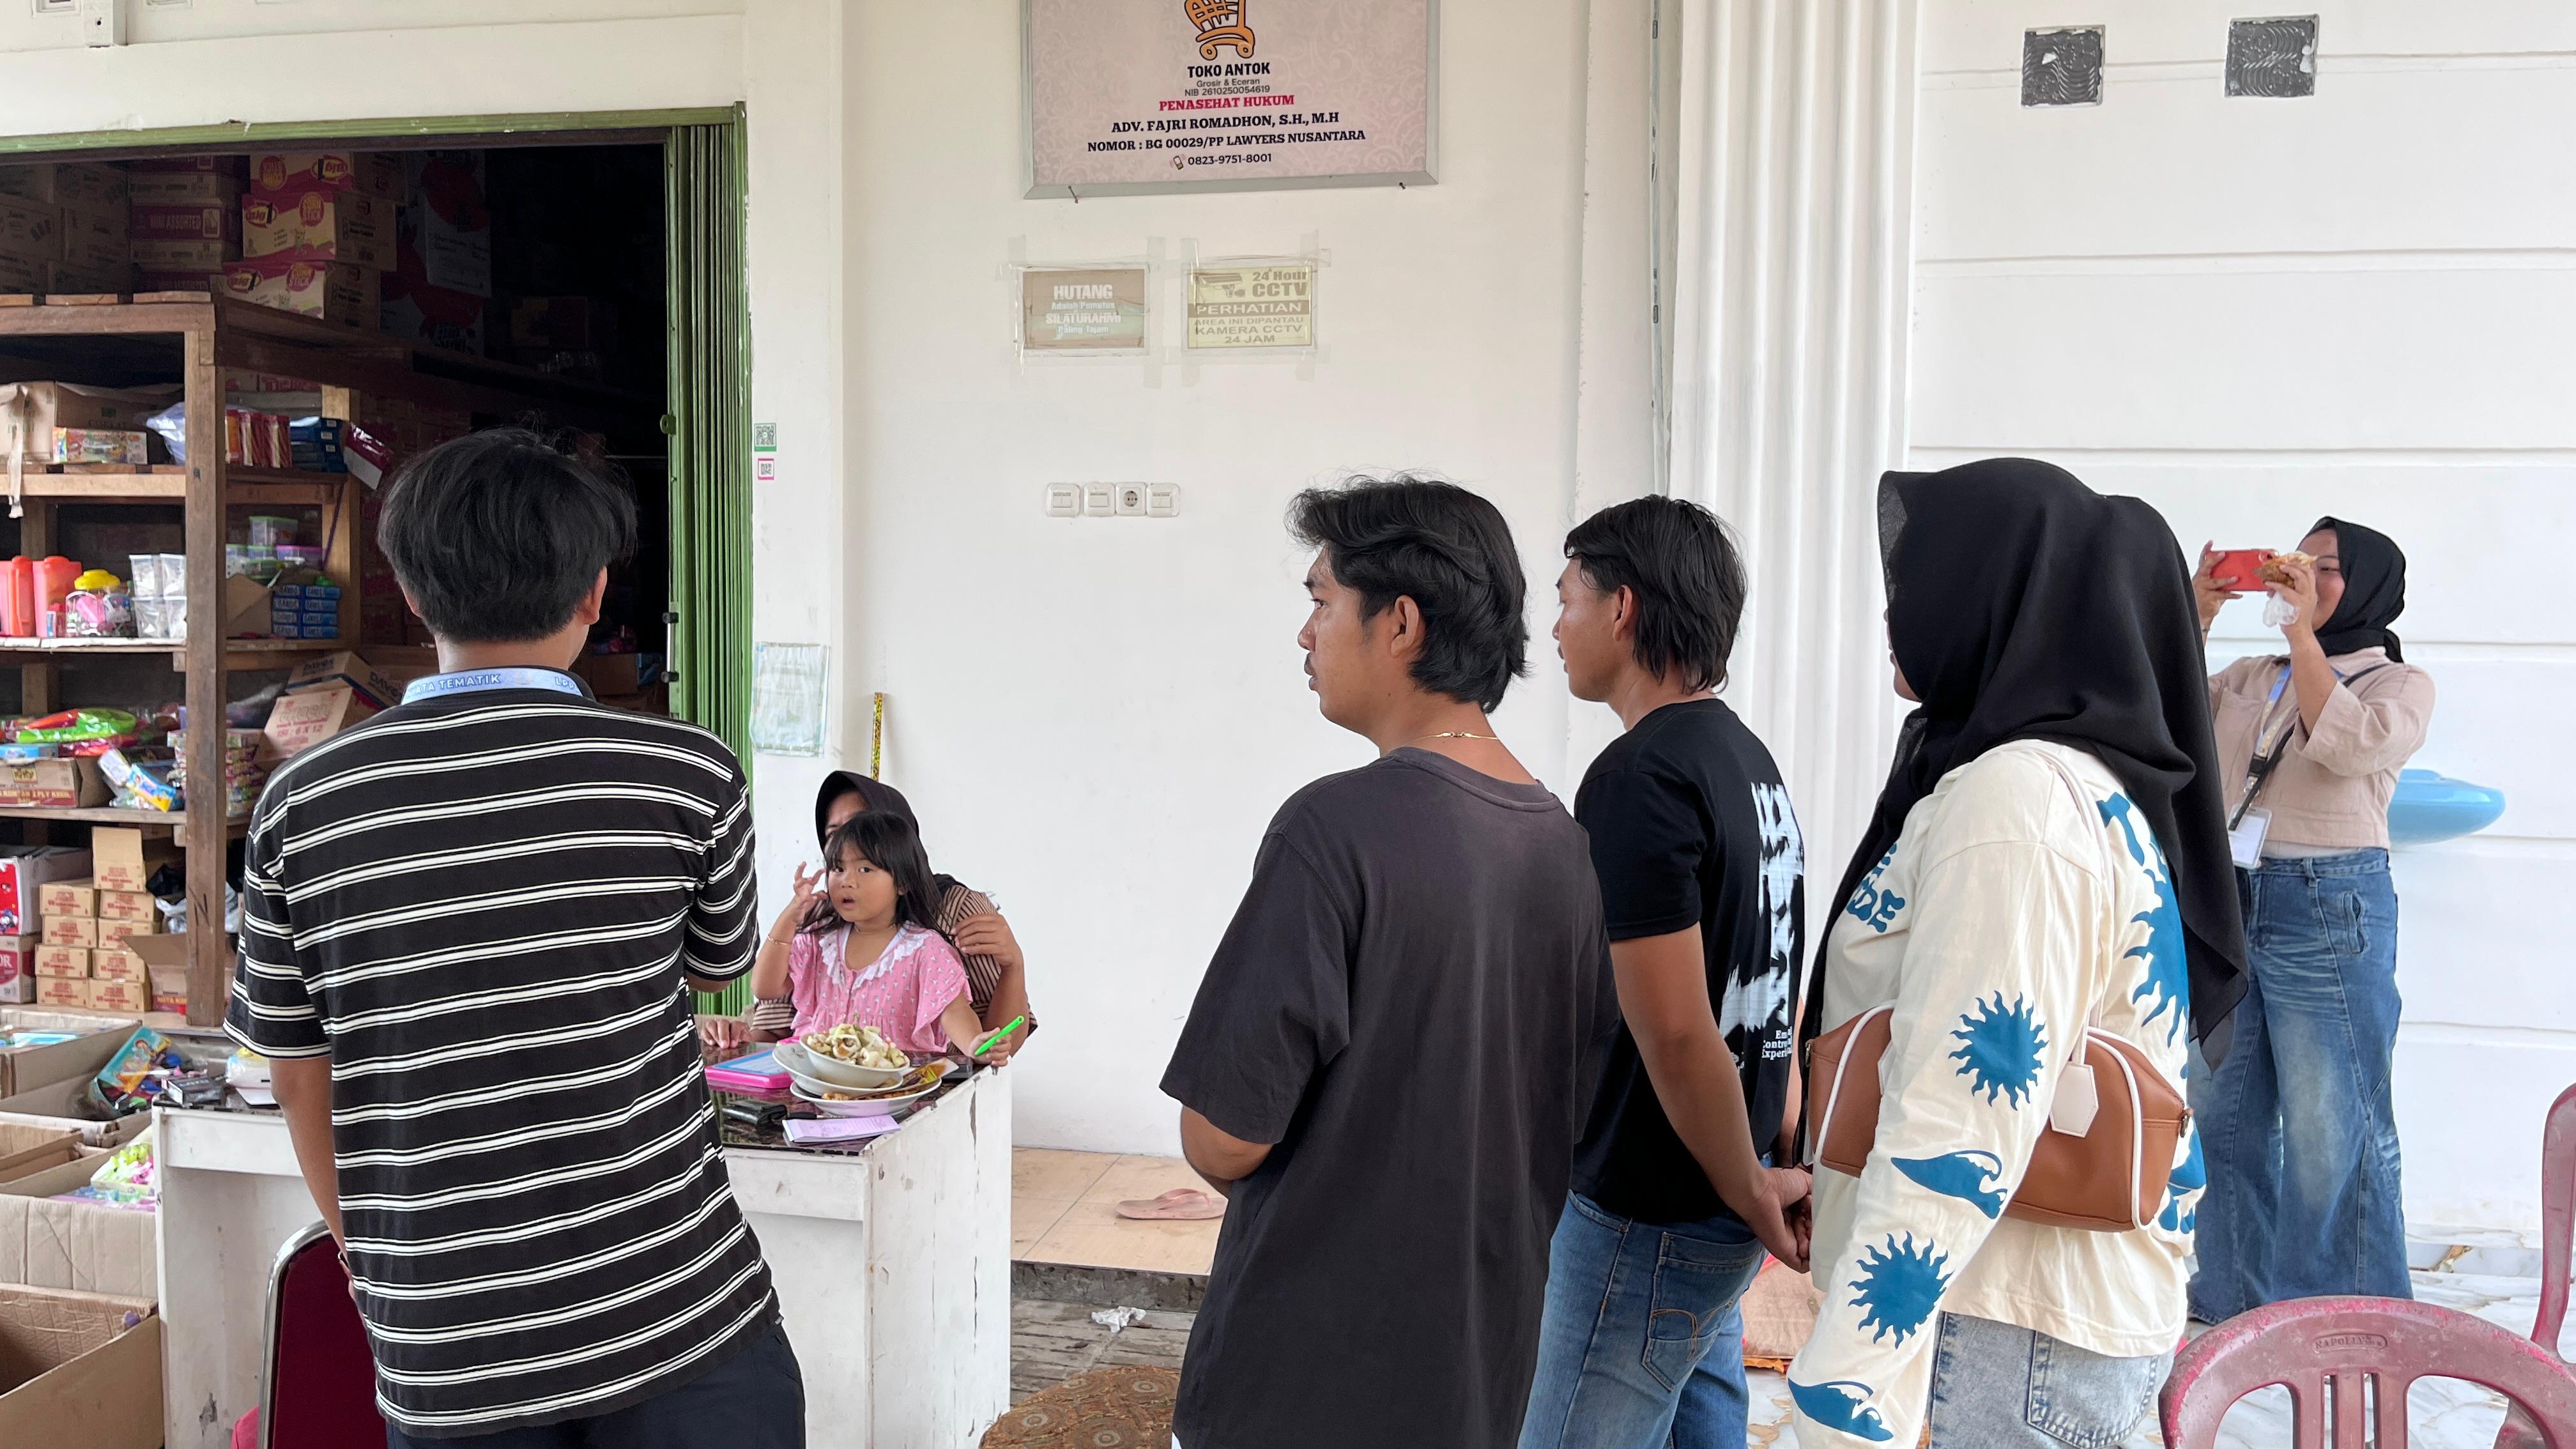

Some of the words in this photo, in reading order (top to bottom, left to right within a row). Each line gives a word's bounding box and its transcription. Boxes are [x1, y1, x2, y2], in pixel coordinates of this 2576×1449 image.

[1187, 65, 1222, 78] TOKO
[1225, 62, 1270, 76] ANTOK
[1197, 79, 1222, 88] Grosir
[1232, 78, 1260, 86] Eceran
[1184, 88, 1199, 96] NIB
[1159, 97, 1240, 111] PENASEHAT
[1243, 95, 1294, 107] HUKUM
[1111, 122, 1144, 133] ADV.
[1147, 119, 1186, 133] FAJRI
[1189, 115, 1276, 129] ROMADHON,
[1279, 114, 1309, 126] S.H.,
[1312, 112, 1339, 123] M.H
[1087, 140, 1136, 152] NOMOR
[1146, 139, 1163, 150] BG
[1165, 136, 1223, 149] 00029/PP
[1227, 134, 1285, 146] LAWYERS
[1287, 130, 1366, 144] NUSANTARA
[1188, 153, 1272, 165] 0823-9751-8001
[1252, 272, 1269, 282] 24
[1273, 271, 1307, 280] Hour
[1054, 284, 1113, 300] HUTANG
[1252, 282, 1308, 297] CCTV
[1197, 302, 1302, 315] PERHATIAN
[1246, 316, 1303, 325] DIPANTAU
[1085, 325, 1109, 334] Tajam
[1197, 326, 1258, 335] KAMERA
[1262, 325, 1303, 334] CCTV
[1245, 335, 1275, 344] JAM
[439, 673, 502, 690] TEMATIK
